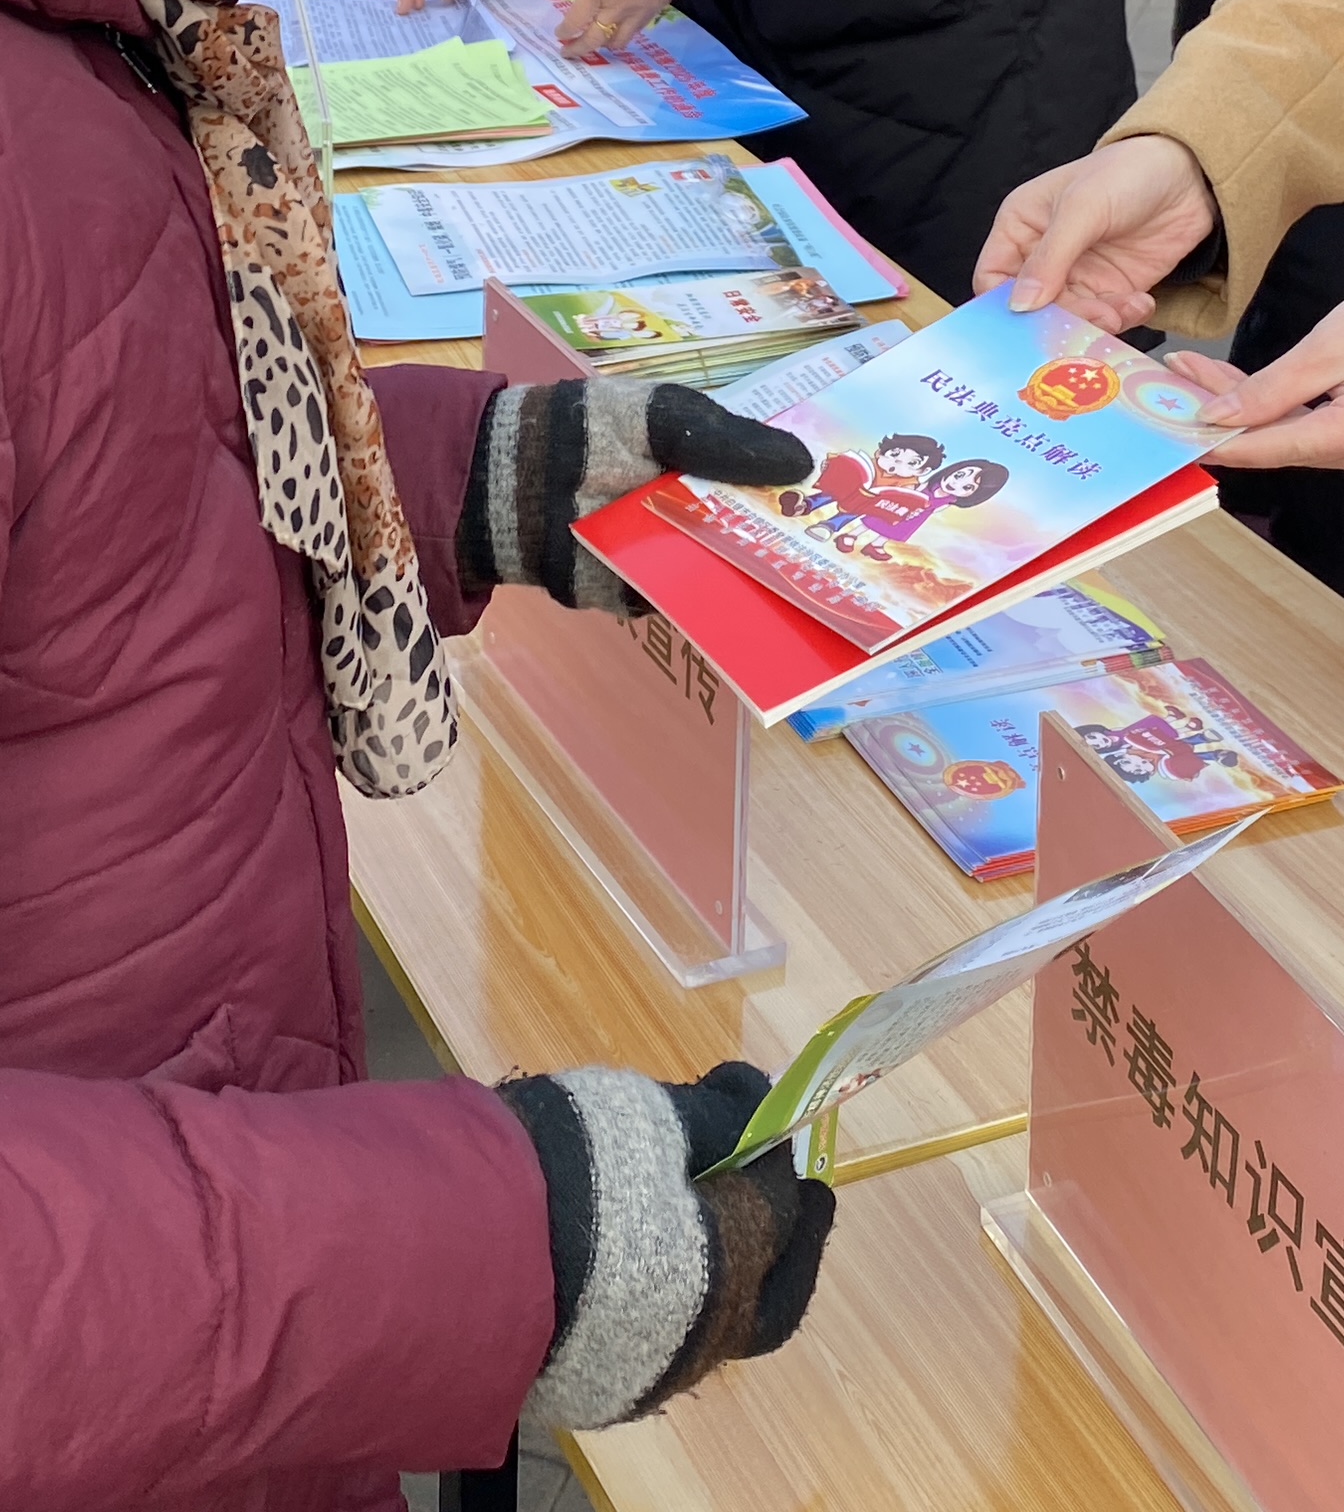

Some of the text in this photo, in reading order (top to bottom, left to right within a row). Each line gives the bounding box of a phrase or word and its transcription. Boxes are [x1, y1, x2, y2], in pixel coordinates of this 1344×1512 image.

[920, 369, 1102, 480] 民法典亮点解读
